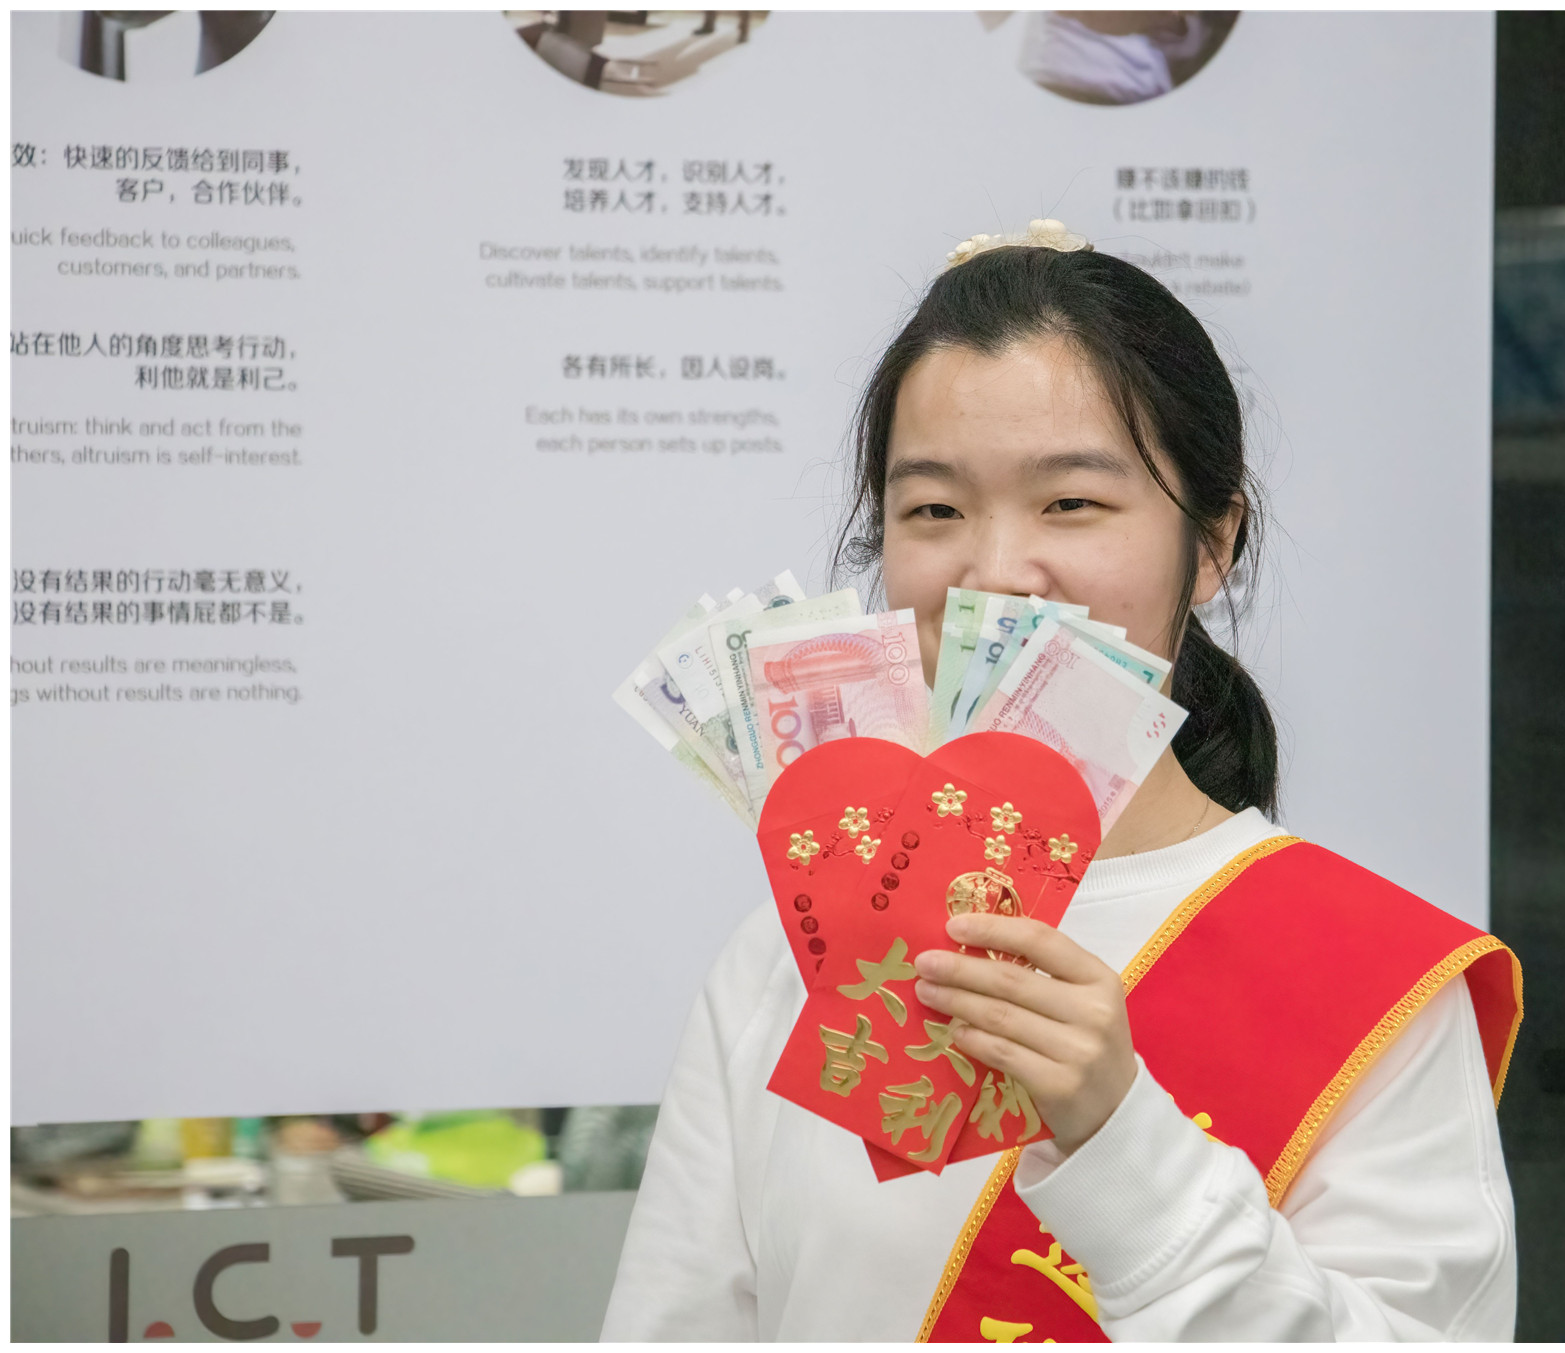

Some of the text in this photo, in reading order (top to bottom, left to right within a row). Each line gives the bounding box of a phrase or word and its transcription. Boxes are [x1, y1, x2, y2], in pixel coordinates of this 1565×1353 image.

[134, 365, 298, 392] 利他就是利己。
[86, 417, 302, 437] think and act from the
